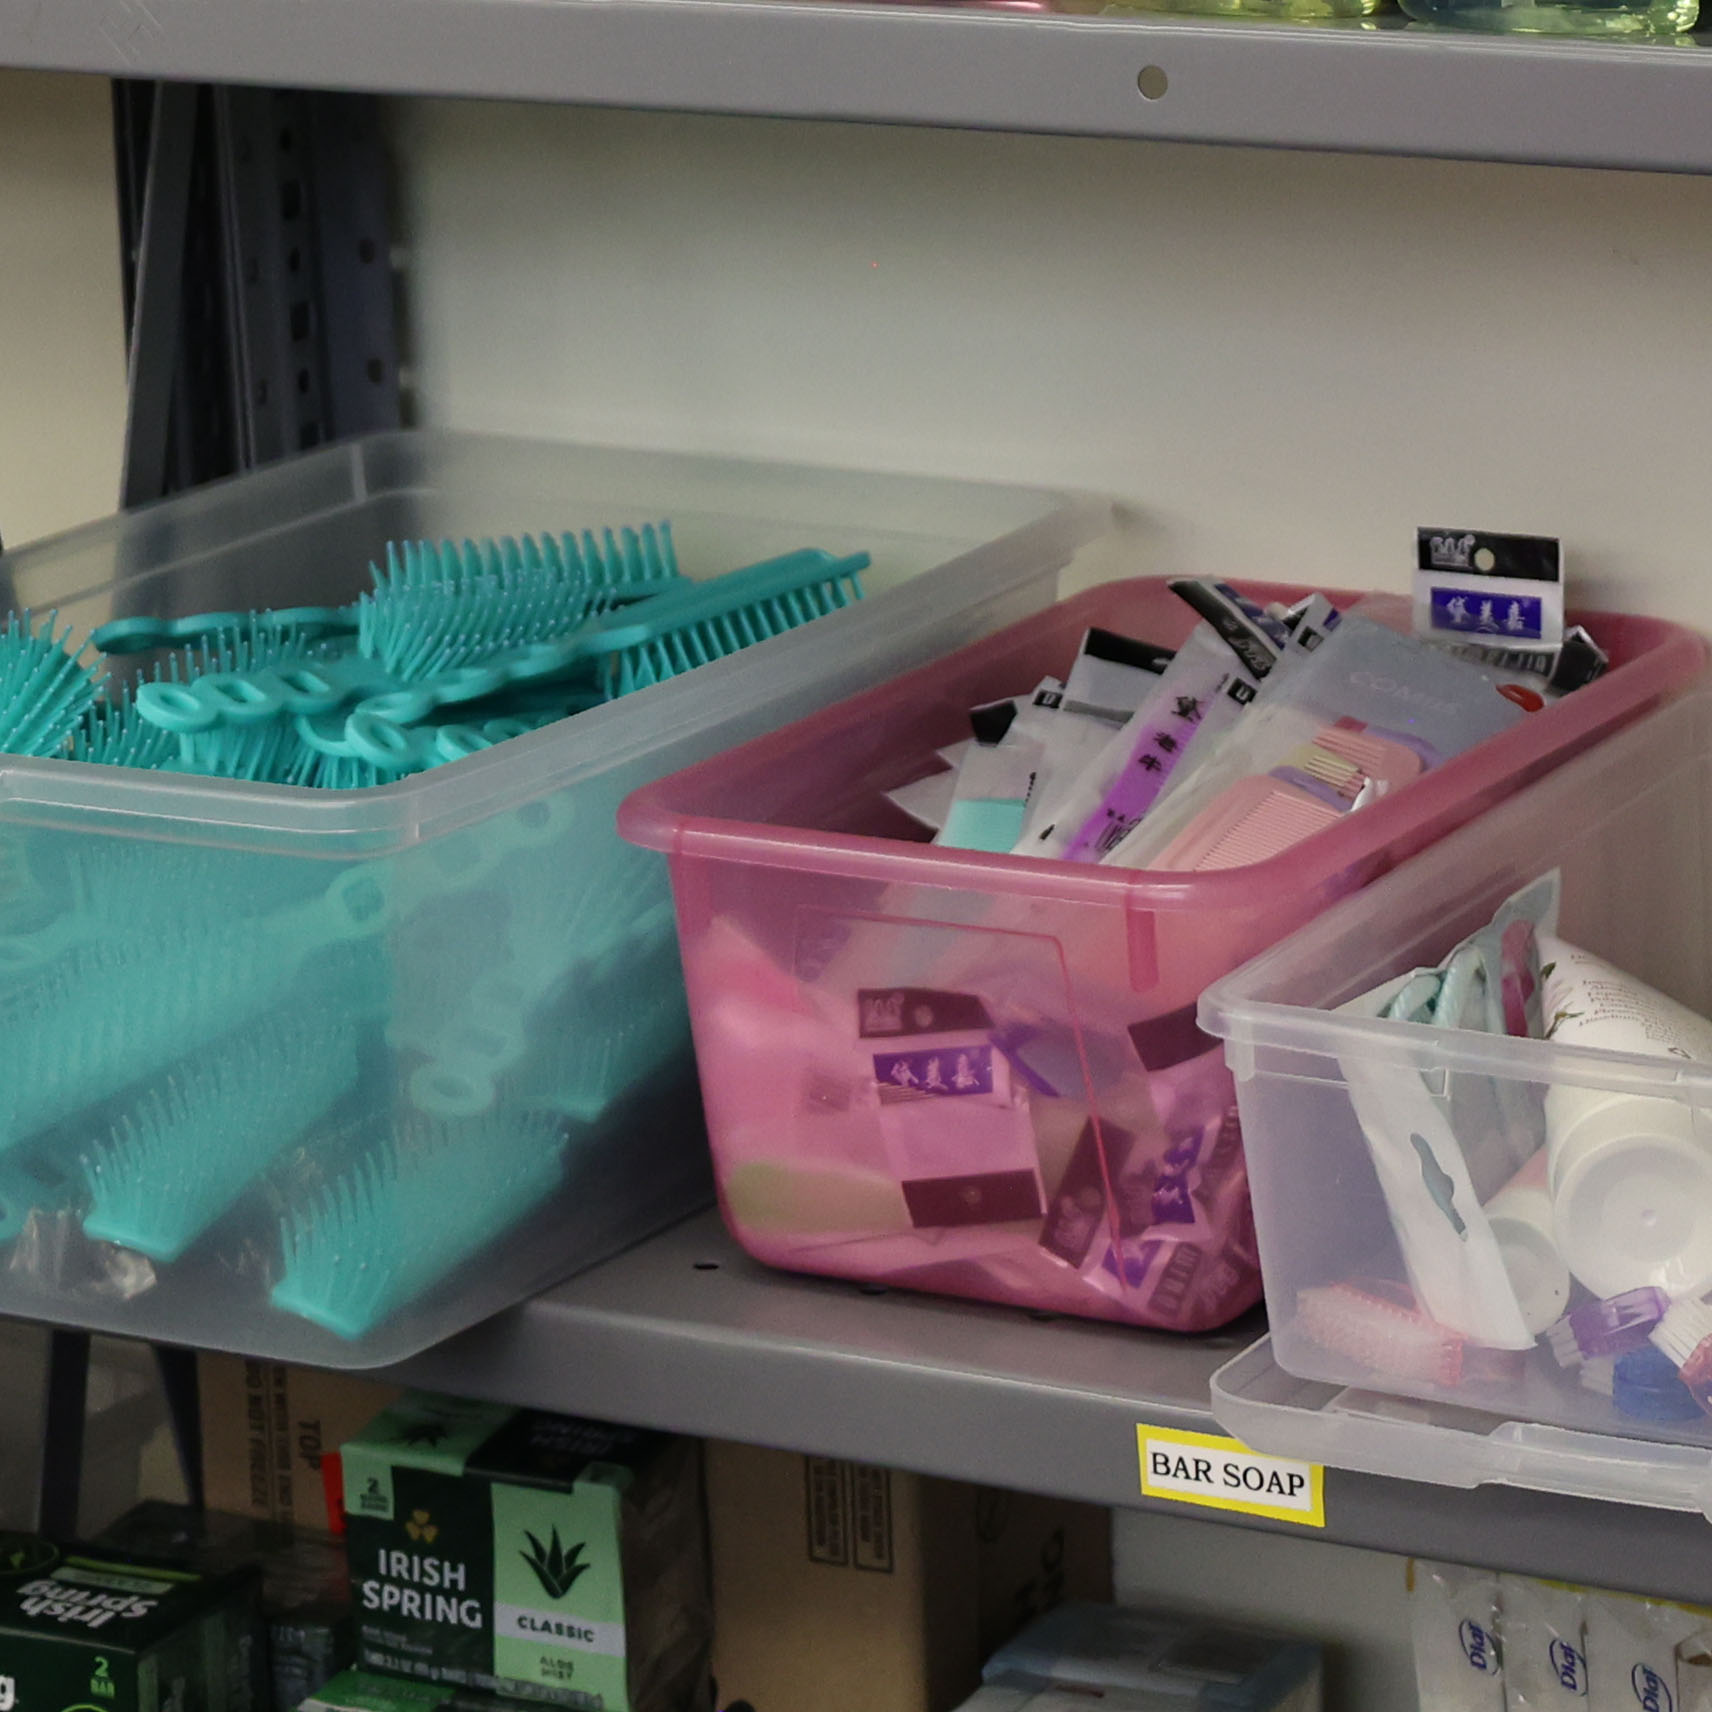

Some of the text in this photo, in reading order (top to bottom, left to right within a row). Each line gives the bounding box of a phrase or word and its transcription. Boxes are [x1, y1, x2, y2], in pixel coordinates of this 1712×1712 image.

[1151, 1452, 1305, 1496] BAR SOAP
[378, 1549, 465, 1591] IRISH
[362, 1580, 482, 1628] SPRING
[518, 1616, 595, 1643] CLASSIC
